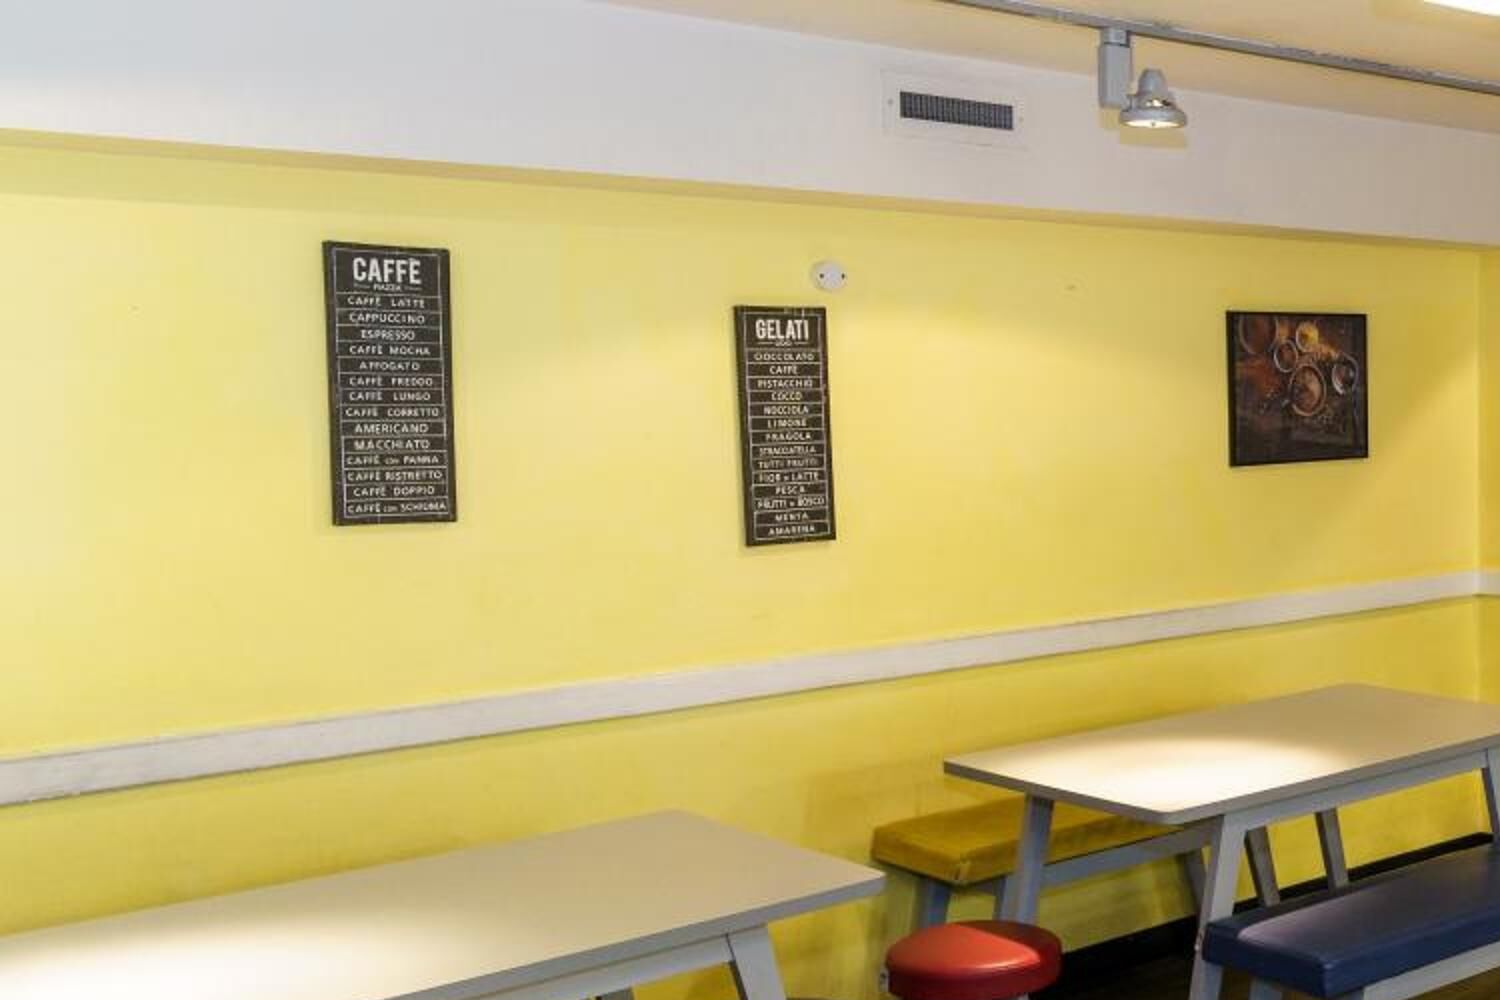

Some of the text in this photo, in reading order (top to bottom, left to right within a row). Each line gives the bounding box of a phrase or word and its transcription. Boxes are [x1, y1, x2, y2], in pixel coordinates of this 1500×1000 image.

[391, 299, 425, 308] LATTE
[349, 312, 425, 324] CAPPUCCINO
[755, 319, 809, 340] GELATI
[361, 329, 415, 341] ESPRESSO
[389, 346, 431, 356] MOCHA
[360, 361, 420, 371] AFFOGATO
[391, 377, 433, 386] FREDDO
[393, 392, 431, 401] LUNGO
[771, 391, 803, 401] COCCO
[387, 408, 439, 417] CORRETTO
[354, 424, 428, 434] AMERICANO
[766, 431, 812, 441] FRAGOLA
[354, 439, 430, 450] MACCHIATO
[403, 455, 439, 464] PANNA
[385, 470, 442, 481] RISTRETTO
[394, 486, 435, 496] DOPPIO
[775, 512, 809, 522] MENTA
